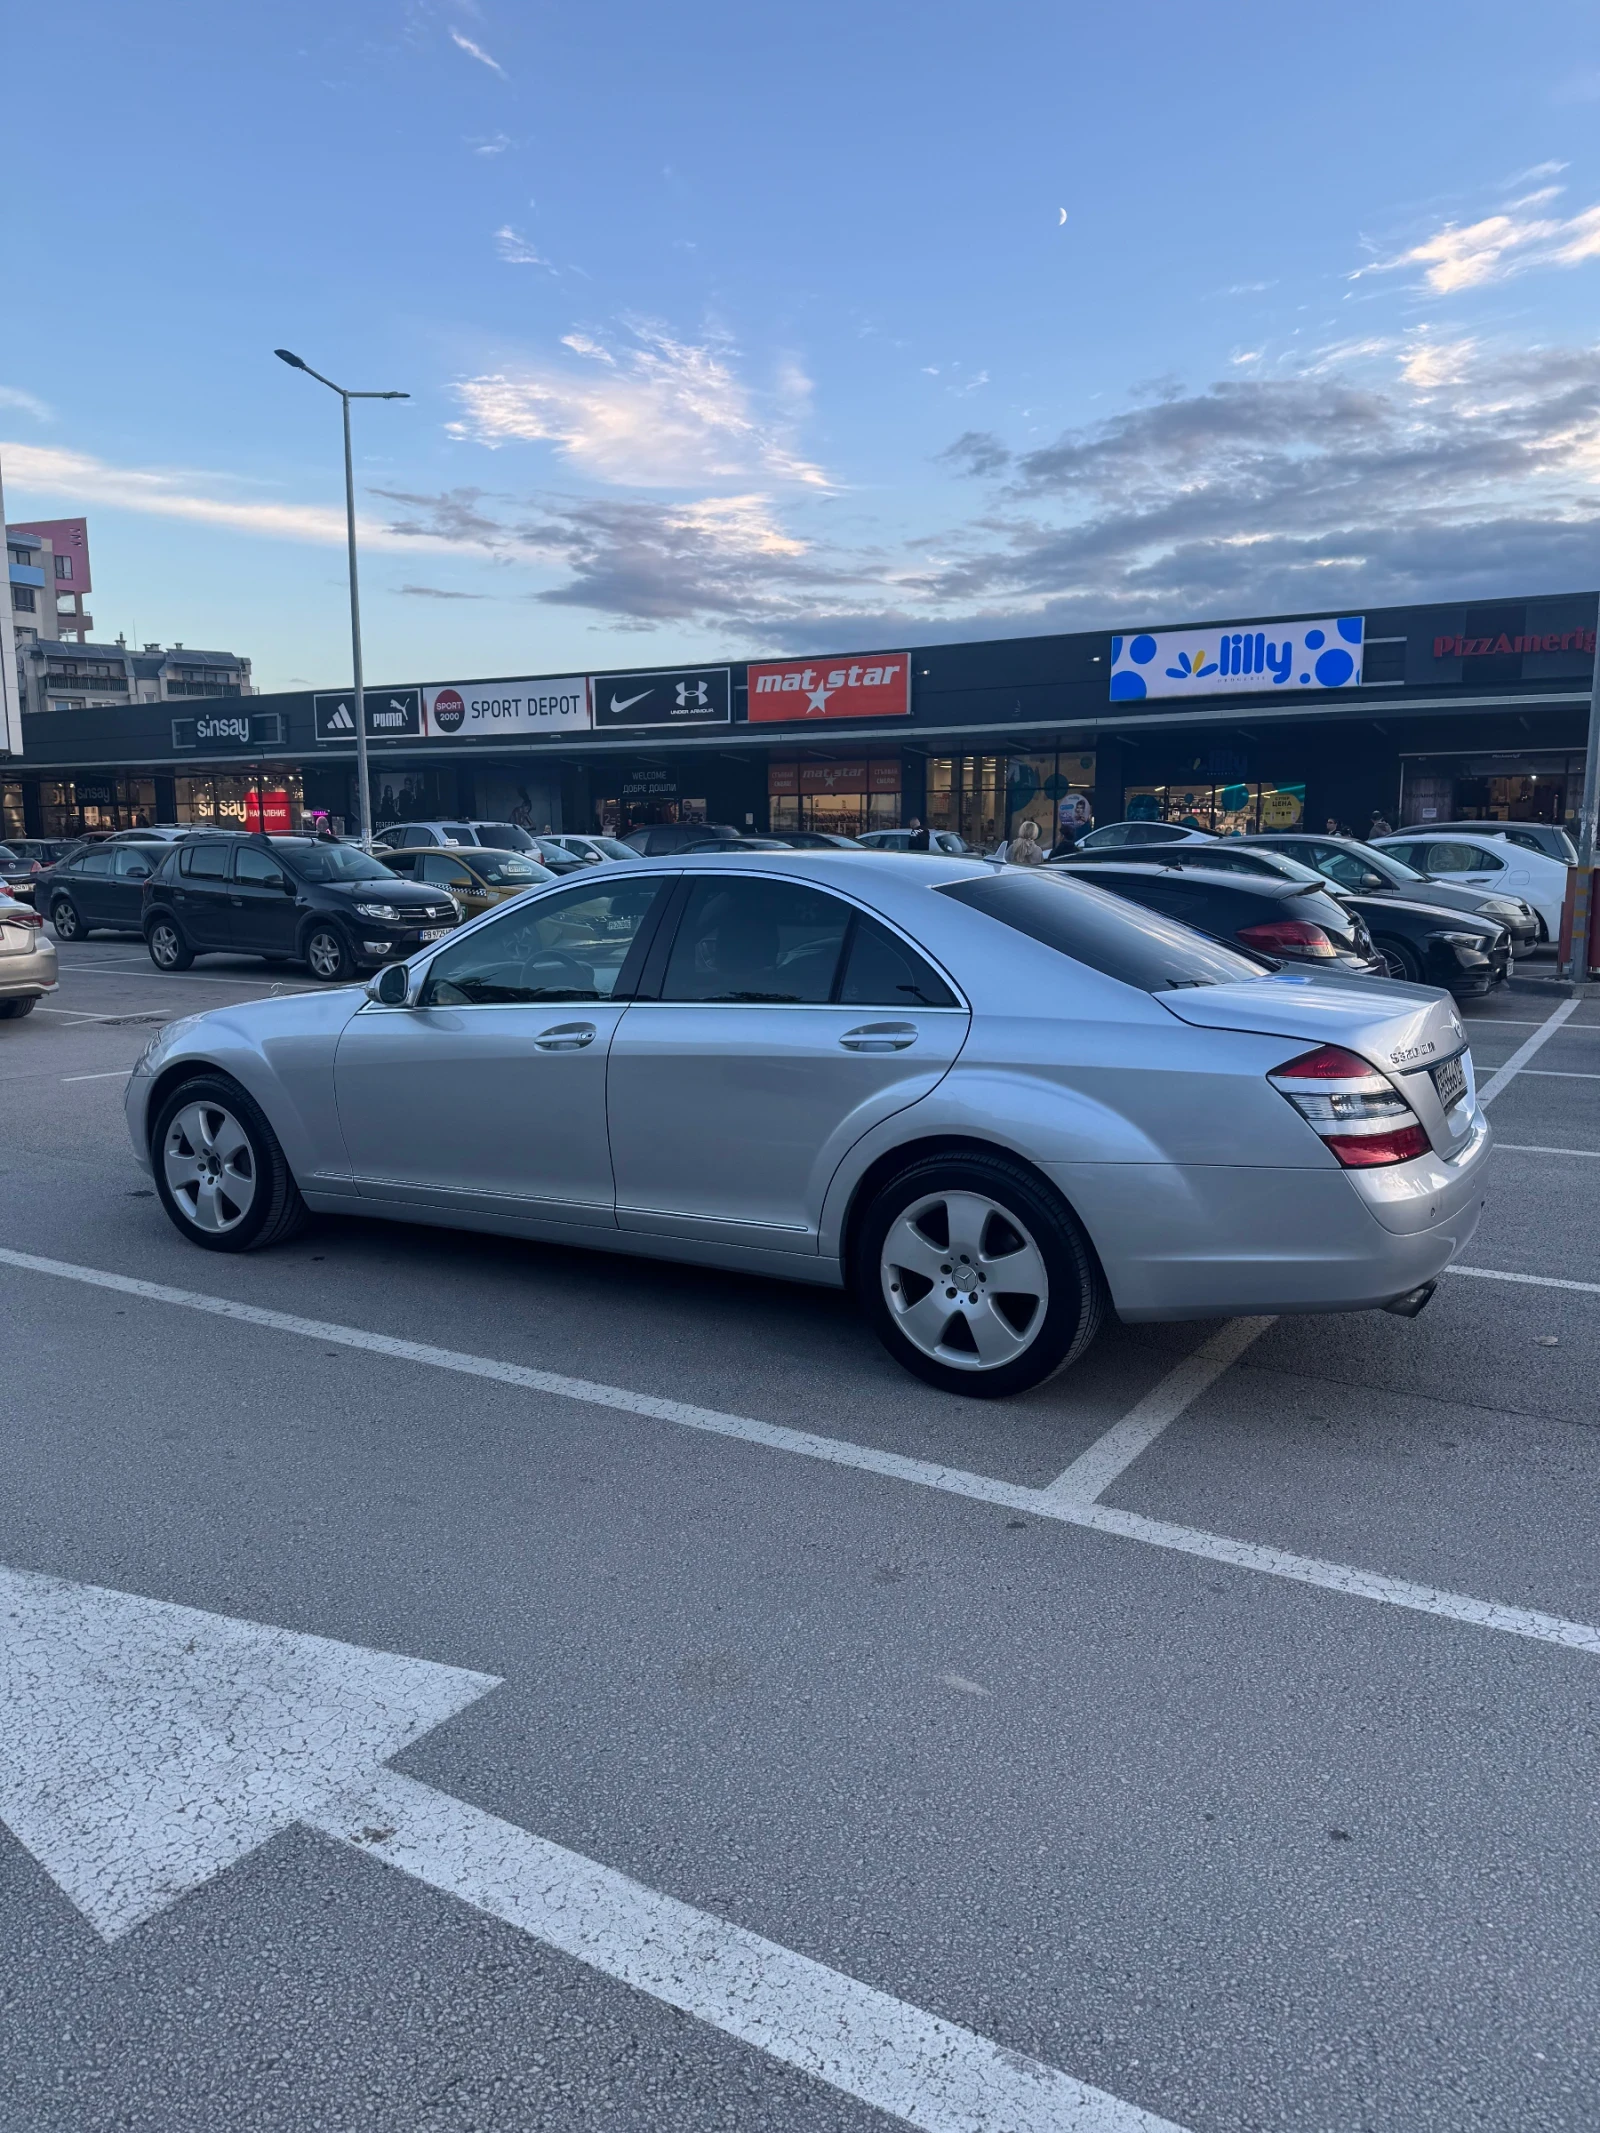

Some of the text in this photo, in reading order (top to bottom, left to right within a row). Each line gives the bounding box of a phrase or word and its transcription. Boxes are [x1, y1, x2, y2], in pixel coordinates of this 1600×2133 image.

[1220, 632, 1292, 684] lilly
[755, 665, 900, 693] mat star
[436, 701, 462, 710] SPORT
[471, 695, 580, 719] SPORT DEPOT
[373, 712, 402, 728] PUMA
[439, 713, 460, 721] 2000
[196, 714, 250, 742] sinsay
[632, 771, 667, 780] WELCOME
[802, 767, 865, 779] mat star
[77, 786, 110, 803] sinsay
[622, 783, 677, 794] ДОБРЕ ДОШЛИ
